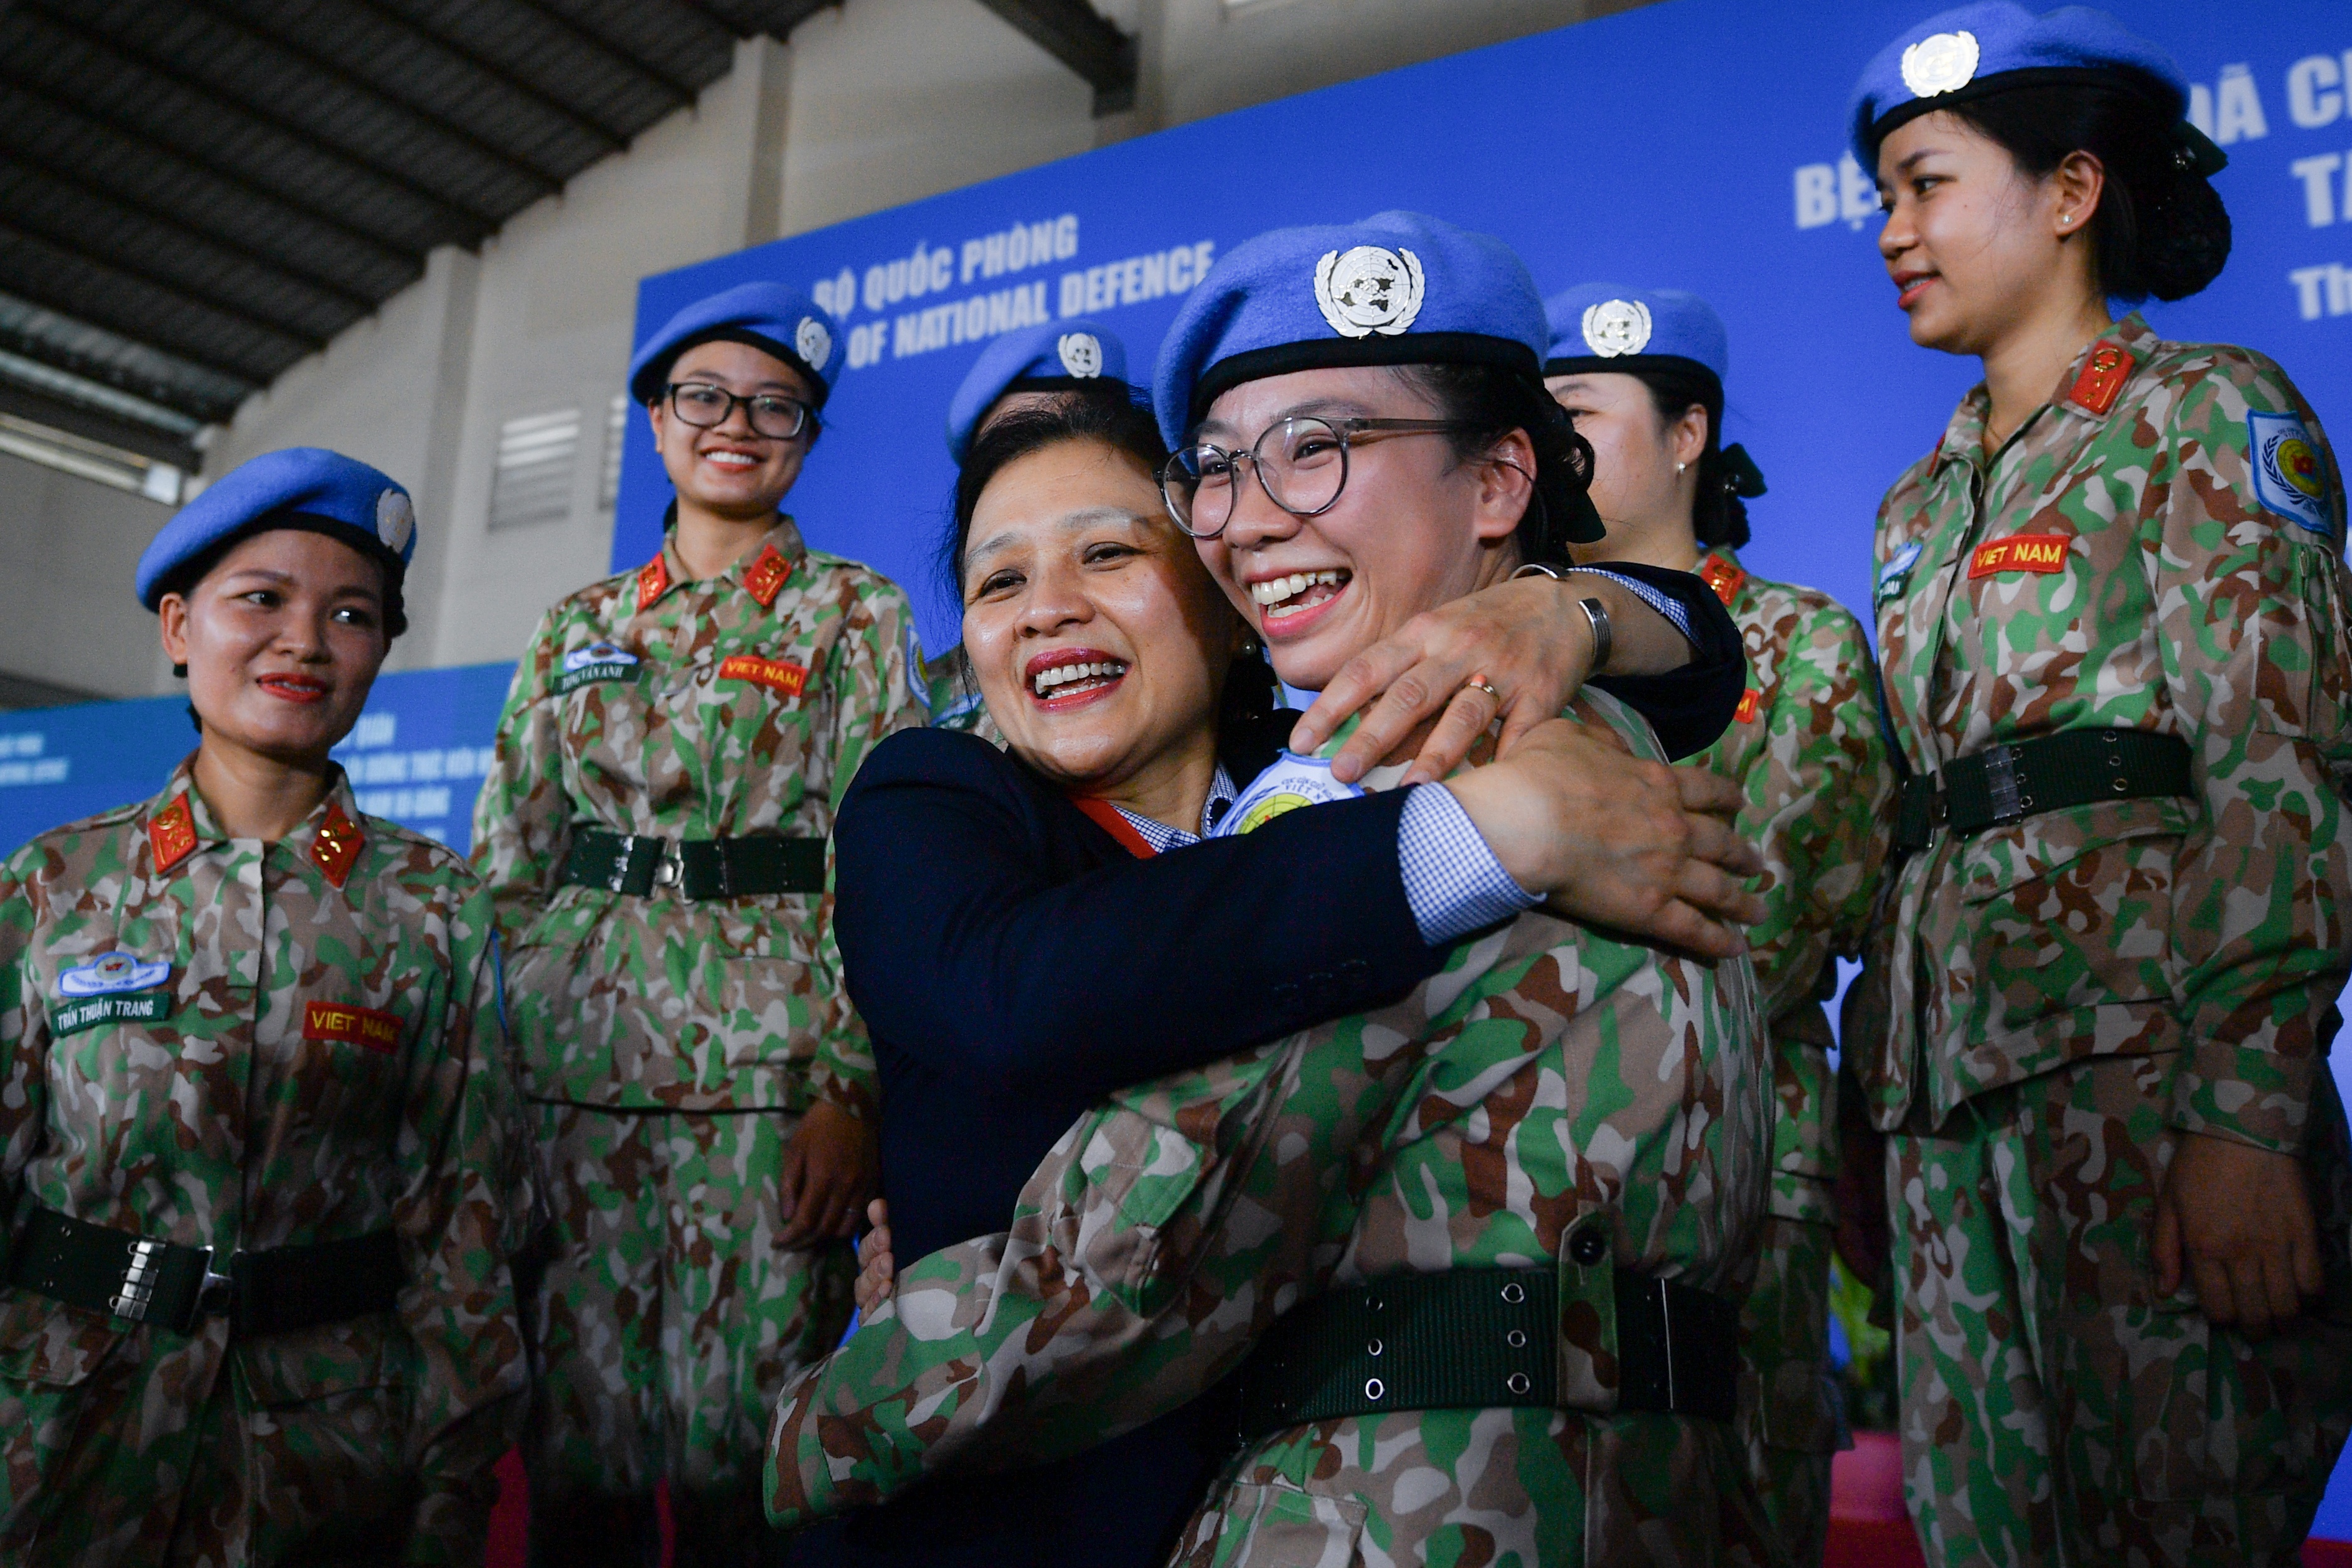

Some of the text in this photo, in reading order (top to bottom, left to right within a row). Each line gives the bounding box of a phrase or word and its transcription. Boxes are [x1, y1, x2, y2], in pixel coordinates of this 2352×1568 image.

[863, 240, 953, 311] QUỐC
[961, 214, 1078, 284] PHÒNG
[847, 240, 1215, 369] OF NATIONAL DEFENCE
[1977, 543, 2062, 568] VIET NAM
[727, 661, 799, 688] VIET NAM
[115, 999, 154, 1017] TRANG
[312, 1010, 397, 1043] VIET NAM
